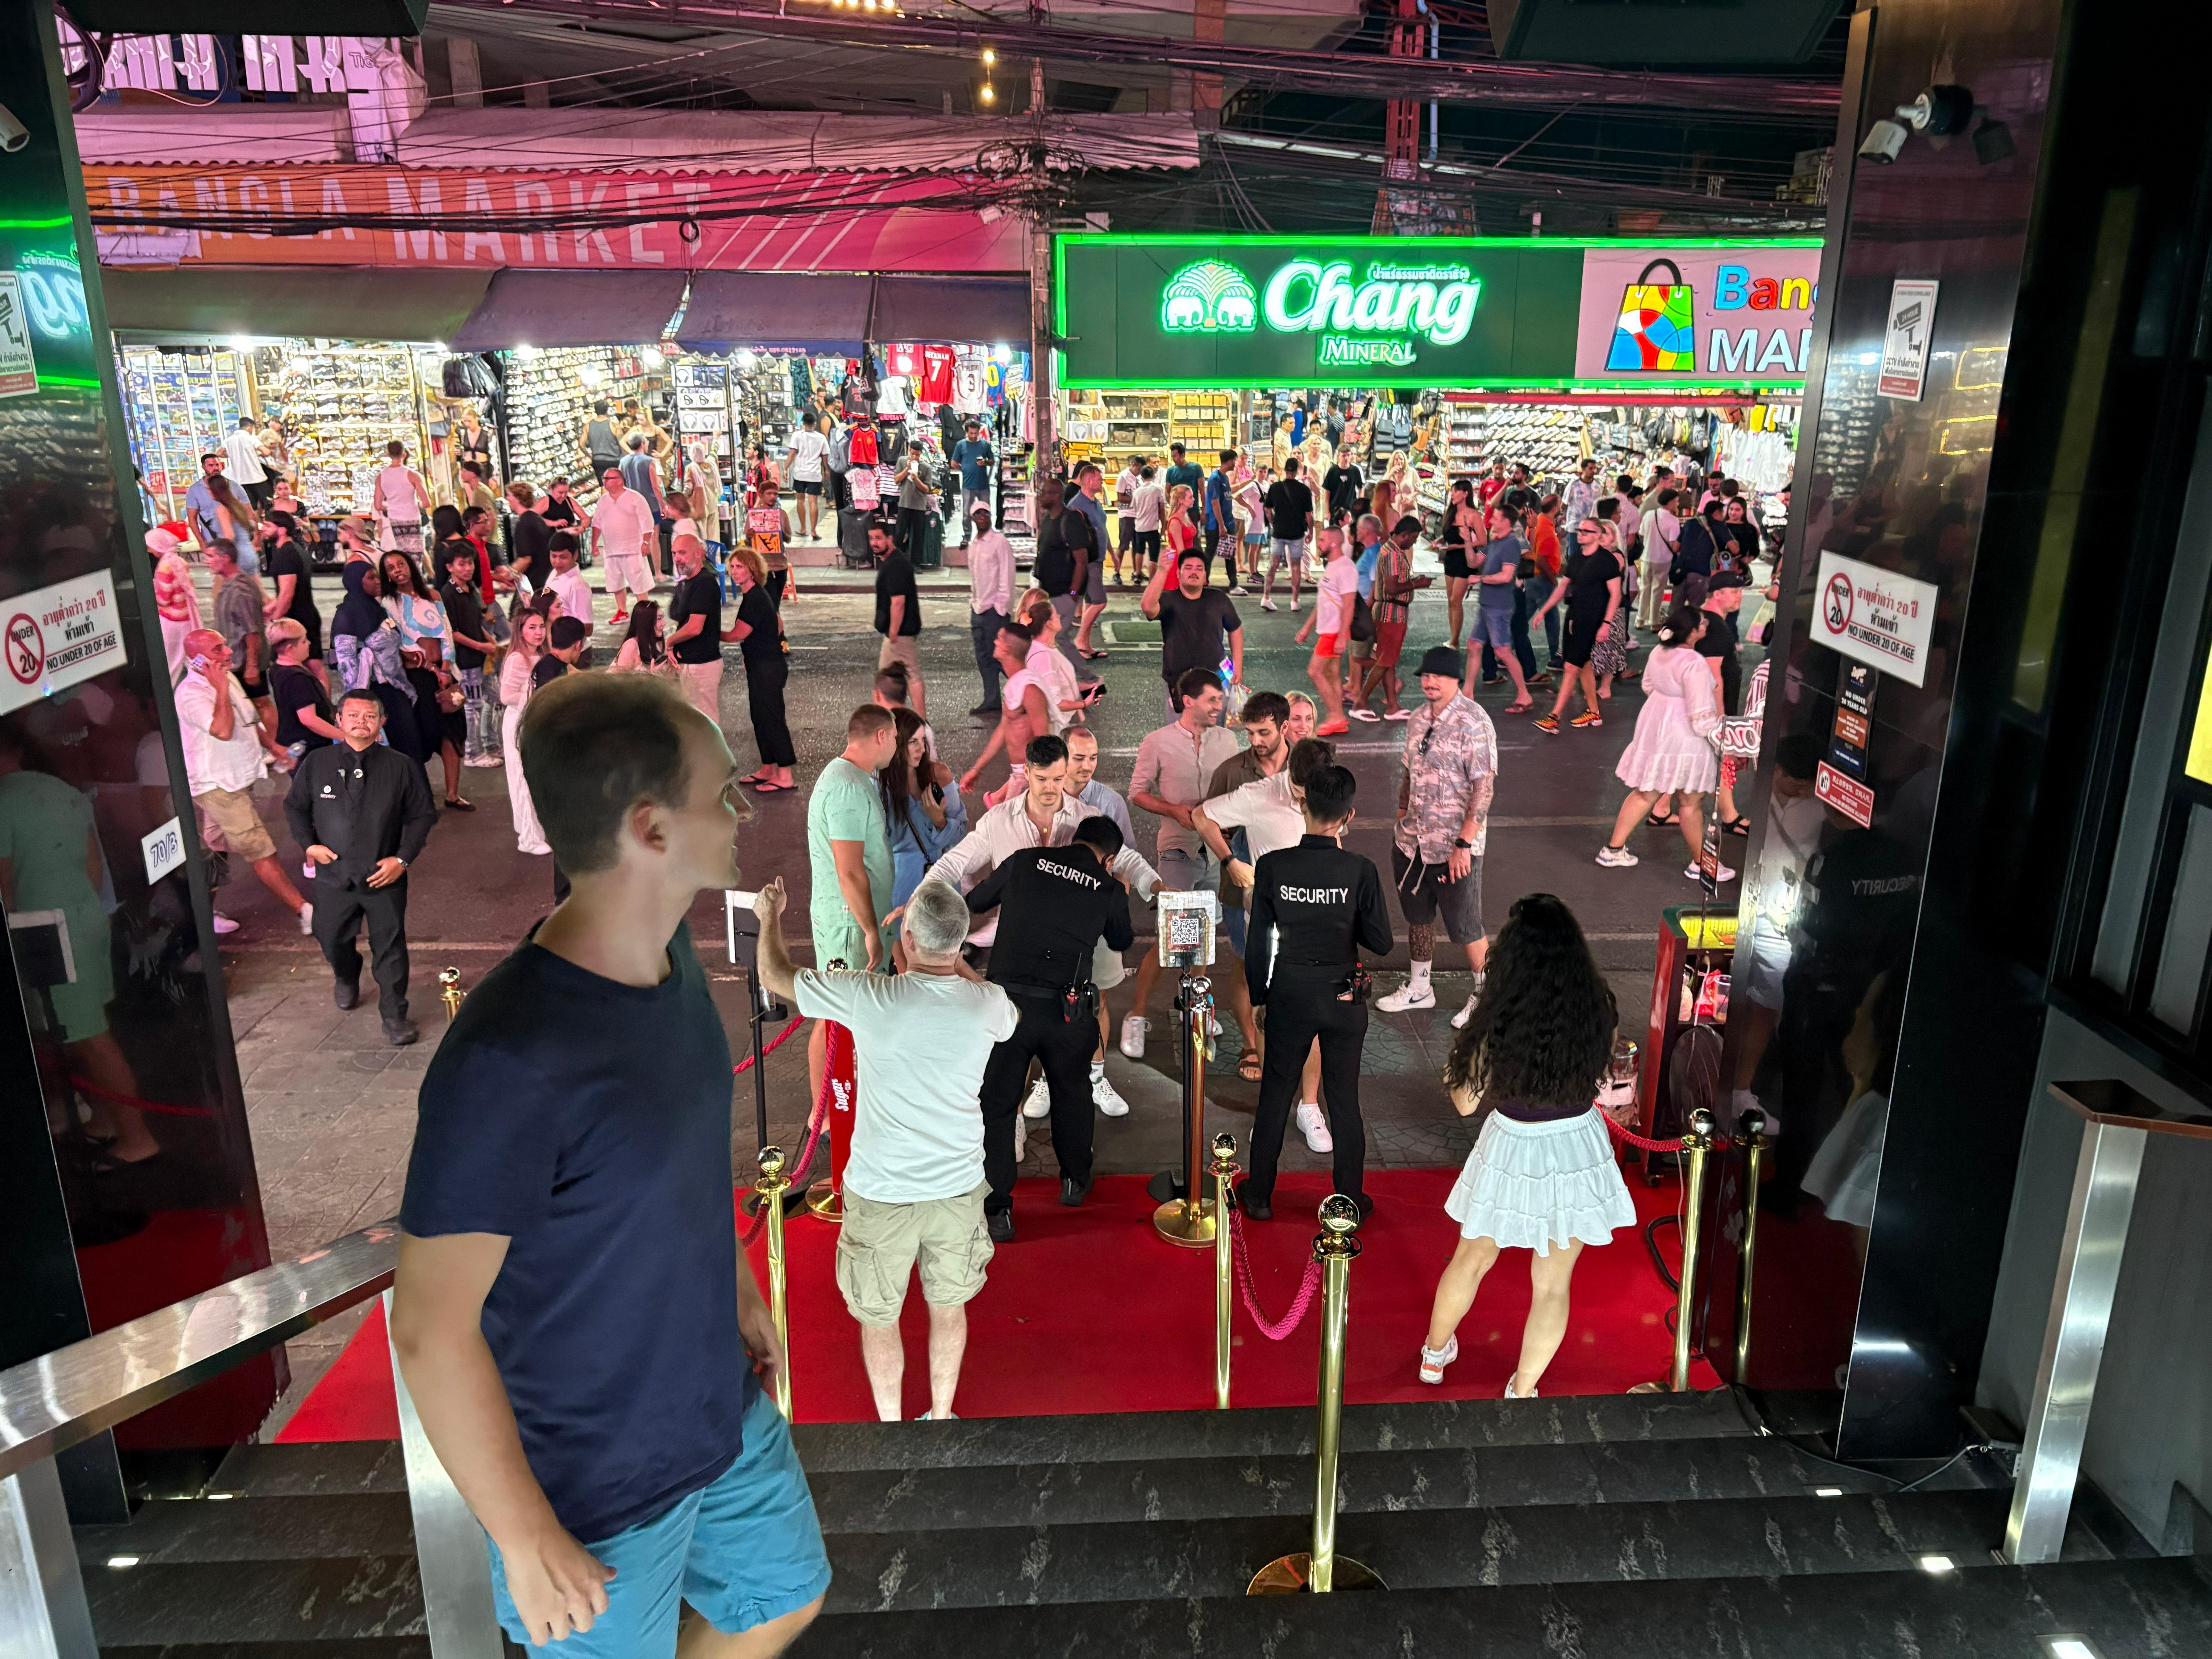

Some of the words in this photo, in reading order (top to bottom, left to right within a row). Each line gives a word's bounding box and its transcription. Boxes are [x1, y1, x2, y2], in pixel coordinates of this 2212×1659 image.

[387, 177, 710, 263] MARKET
[1264, 260, 1481, 345] Chang
[1716, 264, 1819, 322] Ban
[1325, 338, 1417, 363] MINERAL
[931, 361, 942, 382] 7
[888, 434, 895, 449] 7
[1831, 583, 1849, 598] UNDER
[86, 598, 97, 610] 20
[1897, 601, 1908, 615] 20
[1829, 606, 1842, 626] 20
[11, 626, 35, 642] UNDER
[1848, 624, 1858, 636] NO
[1859, 628, 1880, 646] UNDER
[1881, 637, 1889, 649] 20
[1891, 642, 1899, 654] OF
[1901, 647, 1915, 660] AGE
[46, 658, 58, 670] NO
[60, 649, 84, 665] UNDER
[85, 645, 93, 654] 20
[94, 640, 103, 652] OF
[104, 635, 117, 647] AGE
[20, 654, 36, 674] 20
[1845, 690, 1852, 699] NO
[1852, 692, 1865, 705] UNDER
[150, 832, 178, 867] 70/3
[1036, 858, 1101, 891] SECURITY
[1280, 885, 1348, 905] SECURITY
